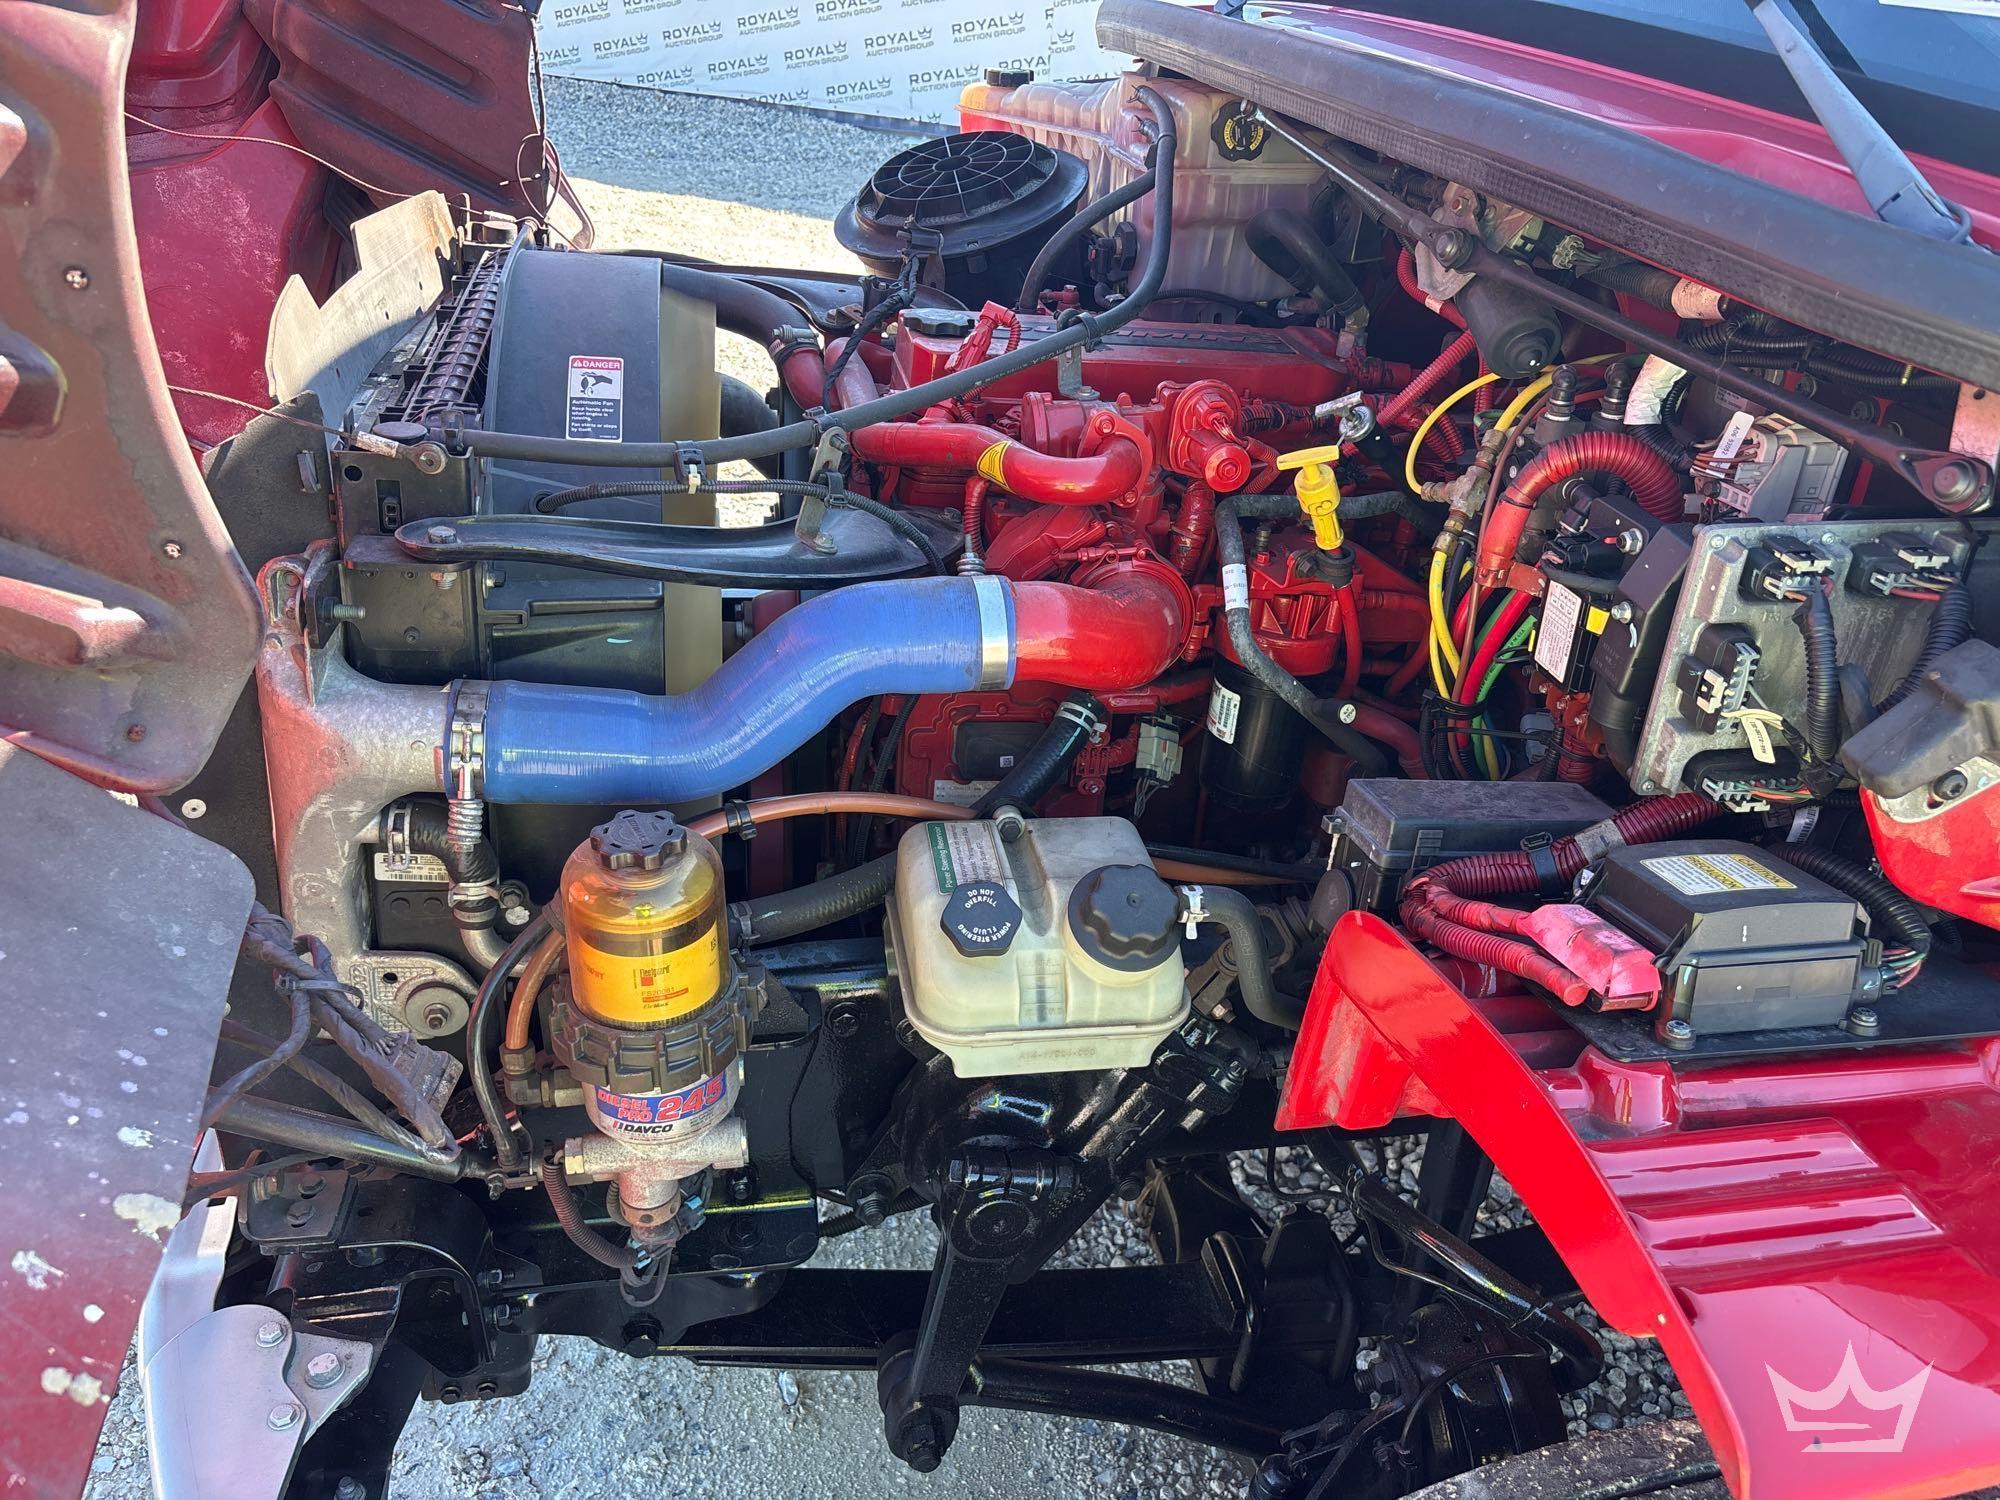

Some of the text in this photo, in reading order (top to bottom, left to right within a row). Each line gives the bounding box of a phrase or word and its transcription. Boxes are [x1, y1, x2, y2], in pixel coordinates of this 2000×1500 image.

[555, 2, 598, 20] ROYAL
[625, 5, 655, 15] AUCTION
[656, 0, 682, 10] GROUP
[818, 6, 882, 22] AUCTION GROUP
[557, 12, 611, 28] AUCTION GROUP
[738, 10, 786, 28] ROYAL
[952, 16, 1008, 34] ROYAL
[663, 24, 710, 40] ROYAL
[740, 20, 800, 36] AUCTION GROUP
[953, 26, 1026, 44] AUCTION GROUP
[594, 36, 638, 53] ROYAL
[665, 34, 724, 48] AUCTION GROUP
[864, 30, 918, 49] ROYAL
[540, 48, 570, 62] OYAL
[596, 46, 650, 60] AUCTION GROUP
[784, 44, 834, 62] ROYAL
[866, 40, 934, 57] AUCTION GROUP
[560, 58, 582, 66] GROUP
[708, 57, 756, 74] ROYAL
[786, 54, 849, 70] AUCTION GROUP
[637, 69, 680, 84] ROYAL
[710, 67, 770, 81] AUCTION GROUP
[909, 68, 964, 85] ROYAL
[670, 79, 695, 88] GROUP
[826, 80, 878, 96] ROYAL
[911, 83, 949, 94] AUCTION
[828, 90, 894, 104] AUCTION GROUP
[582, 360, 620, 369] DANGER
[934, 826, 954, 888] Power Steering Reservoir
[967, 888, 995, 898] DO NOT
[964, 896, 998, 909] OVERFILL
[958, 922, 1011, 942] POWER STEERING
[973, 926, 997, 936] FLUID
[640, 964, 670, 977] Fleetguard
[597, 1089, 650, 1110] DIESEL
[655, 1074, 724, 1123] 245
[618, 1109, 652, 1122] PRO
[624, 1124, 674, 1134] DAVCO
